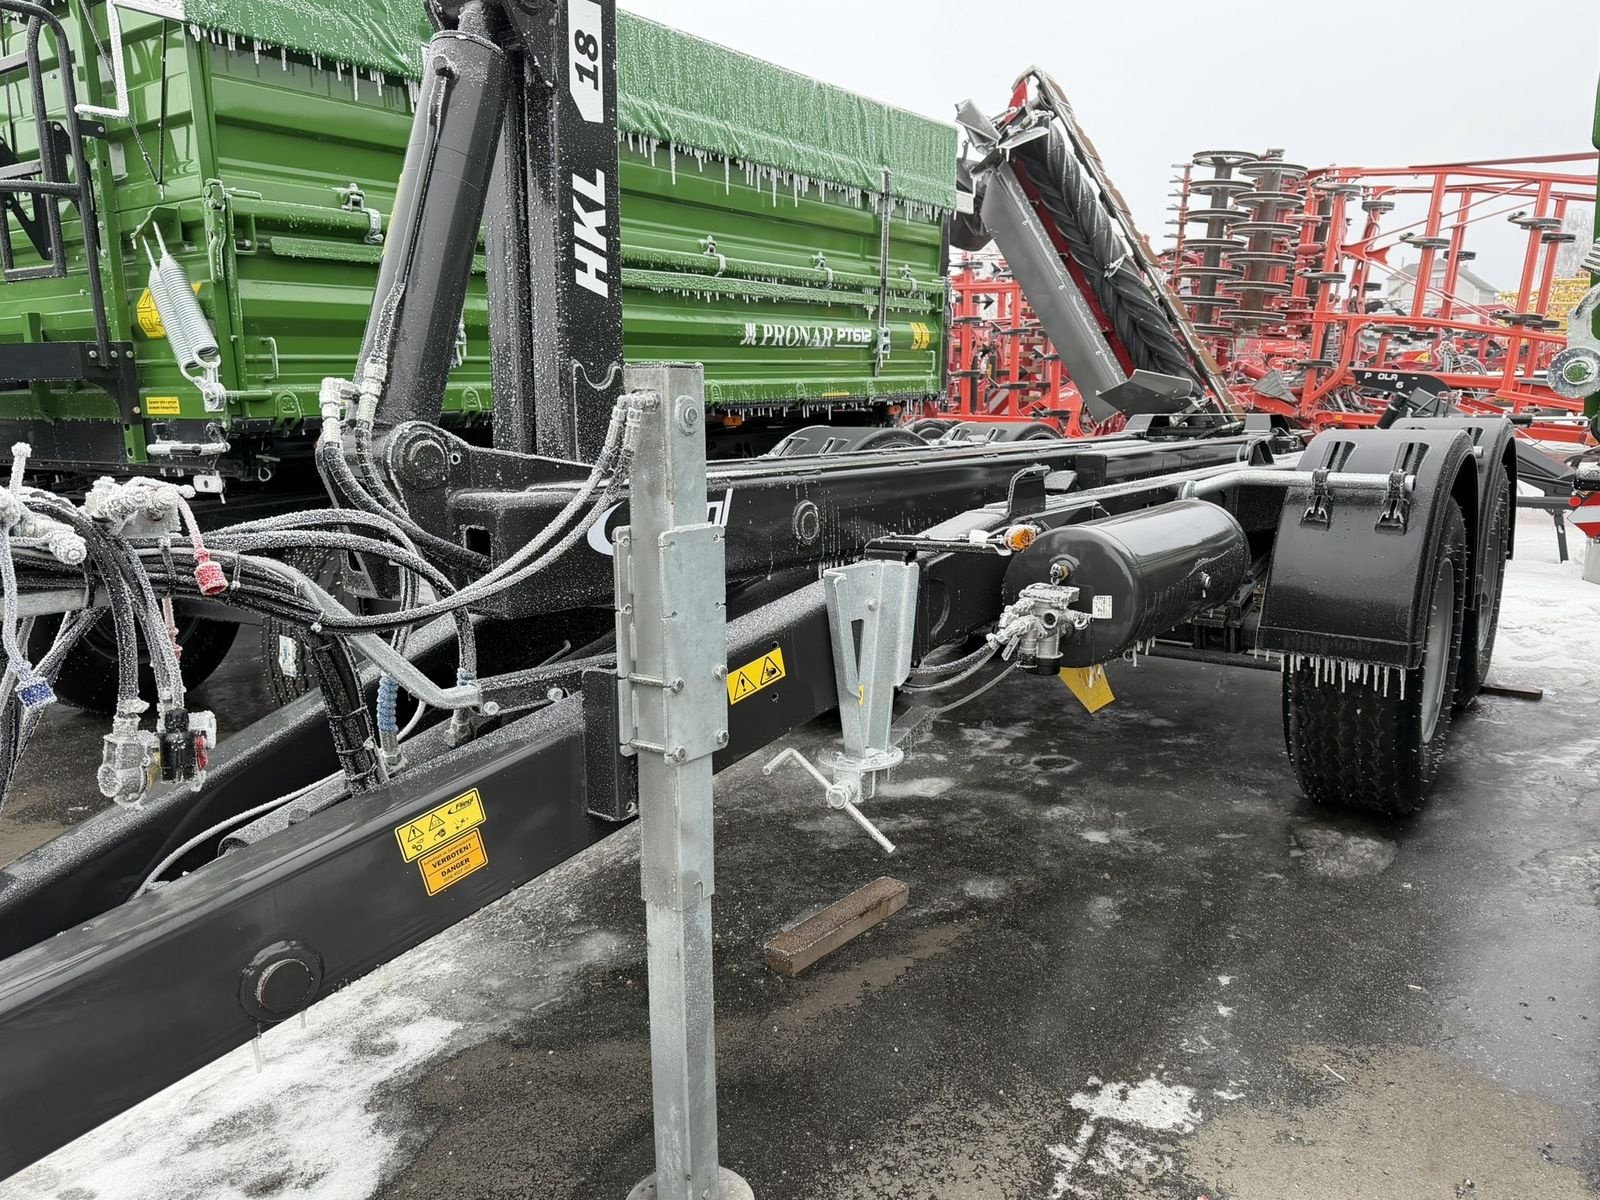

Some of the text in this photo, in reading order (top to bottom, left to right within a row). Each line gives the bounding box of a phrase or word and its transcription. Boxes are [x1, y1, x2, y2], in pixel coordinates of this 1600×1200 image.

[572, 29, 609, 299] HKL 18
[759, 323, 872, 347] PRONAR PT612
[432, 843, 472, 869] VERBOTEN!
[441, 857, 470, 877] DANGER
